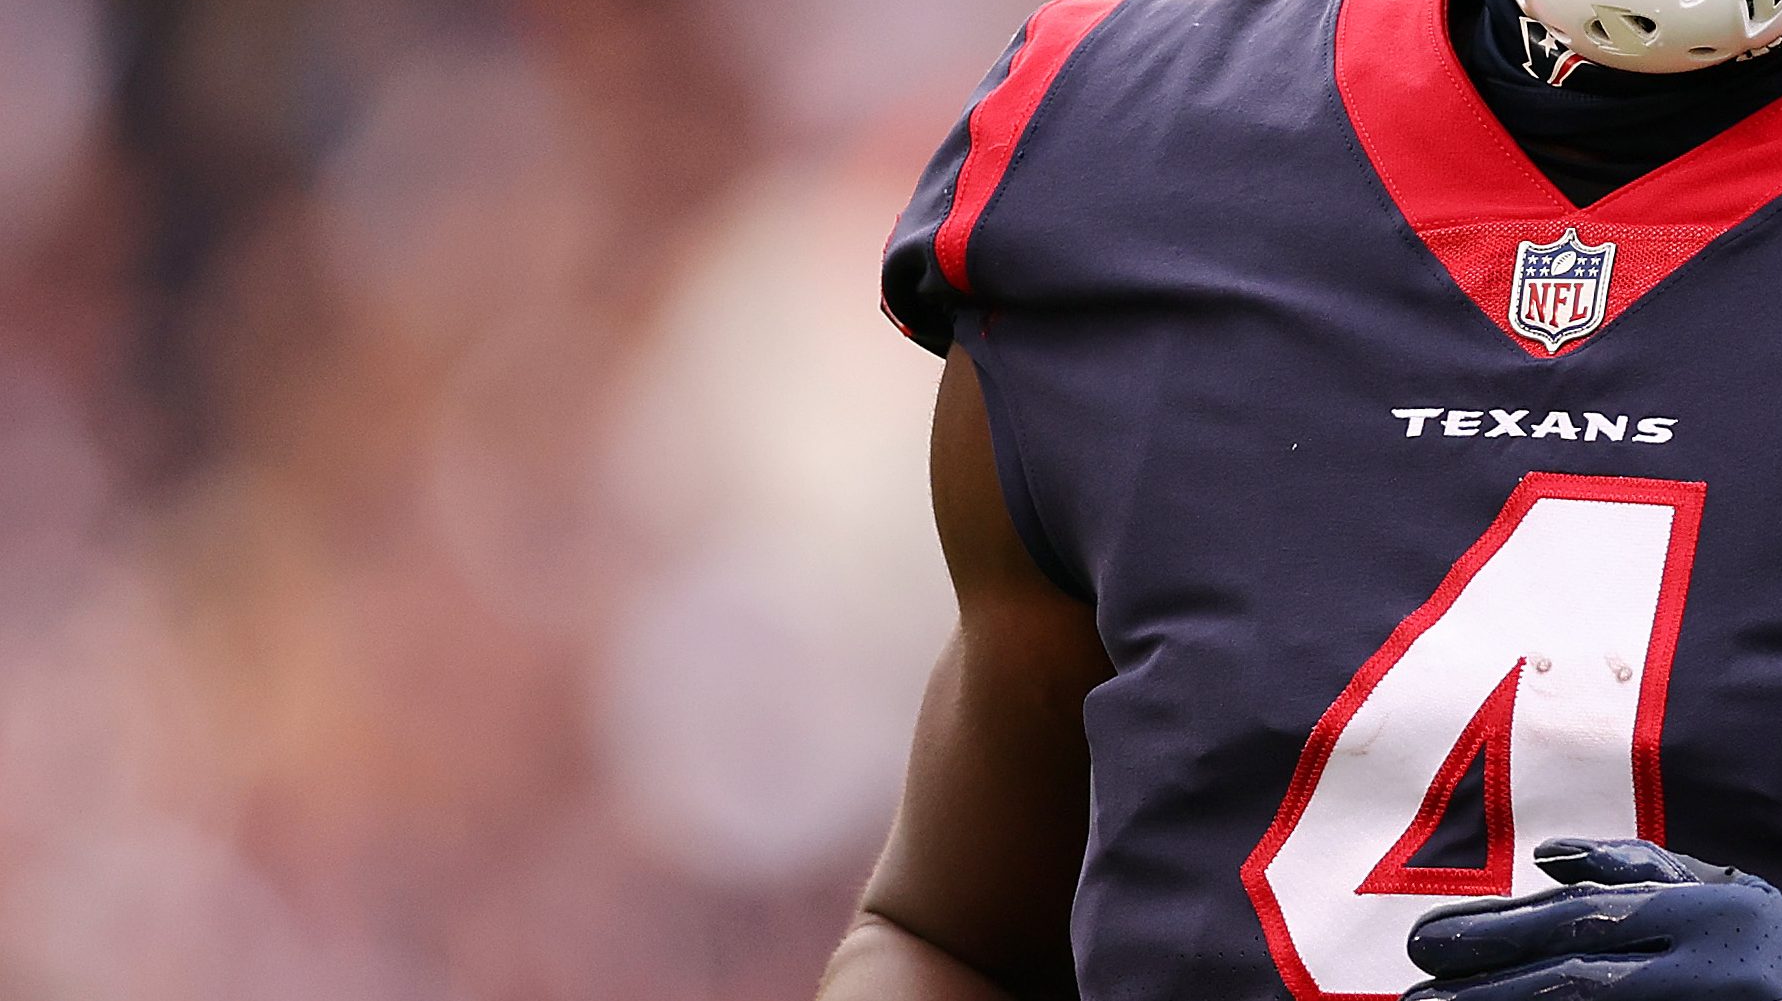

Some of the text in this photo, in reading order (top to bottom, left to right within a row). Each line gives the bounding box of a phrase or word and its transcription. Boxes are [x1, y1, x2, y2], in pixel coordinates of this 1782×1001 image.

[1525, 283, 1588, 328] NFL
[1391, 408, 1679, 443] TEXANS
[1241, 472, 1707, 1001] 4
